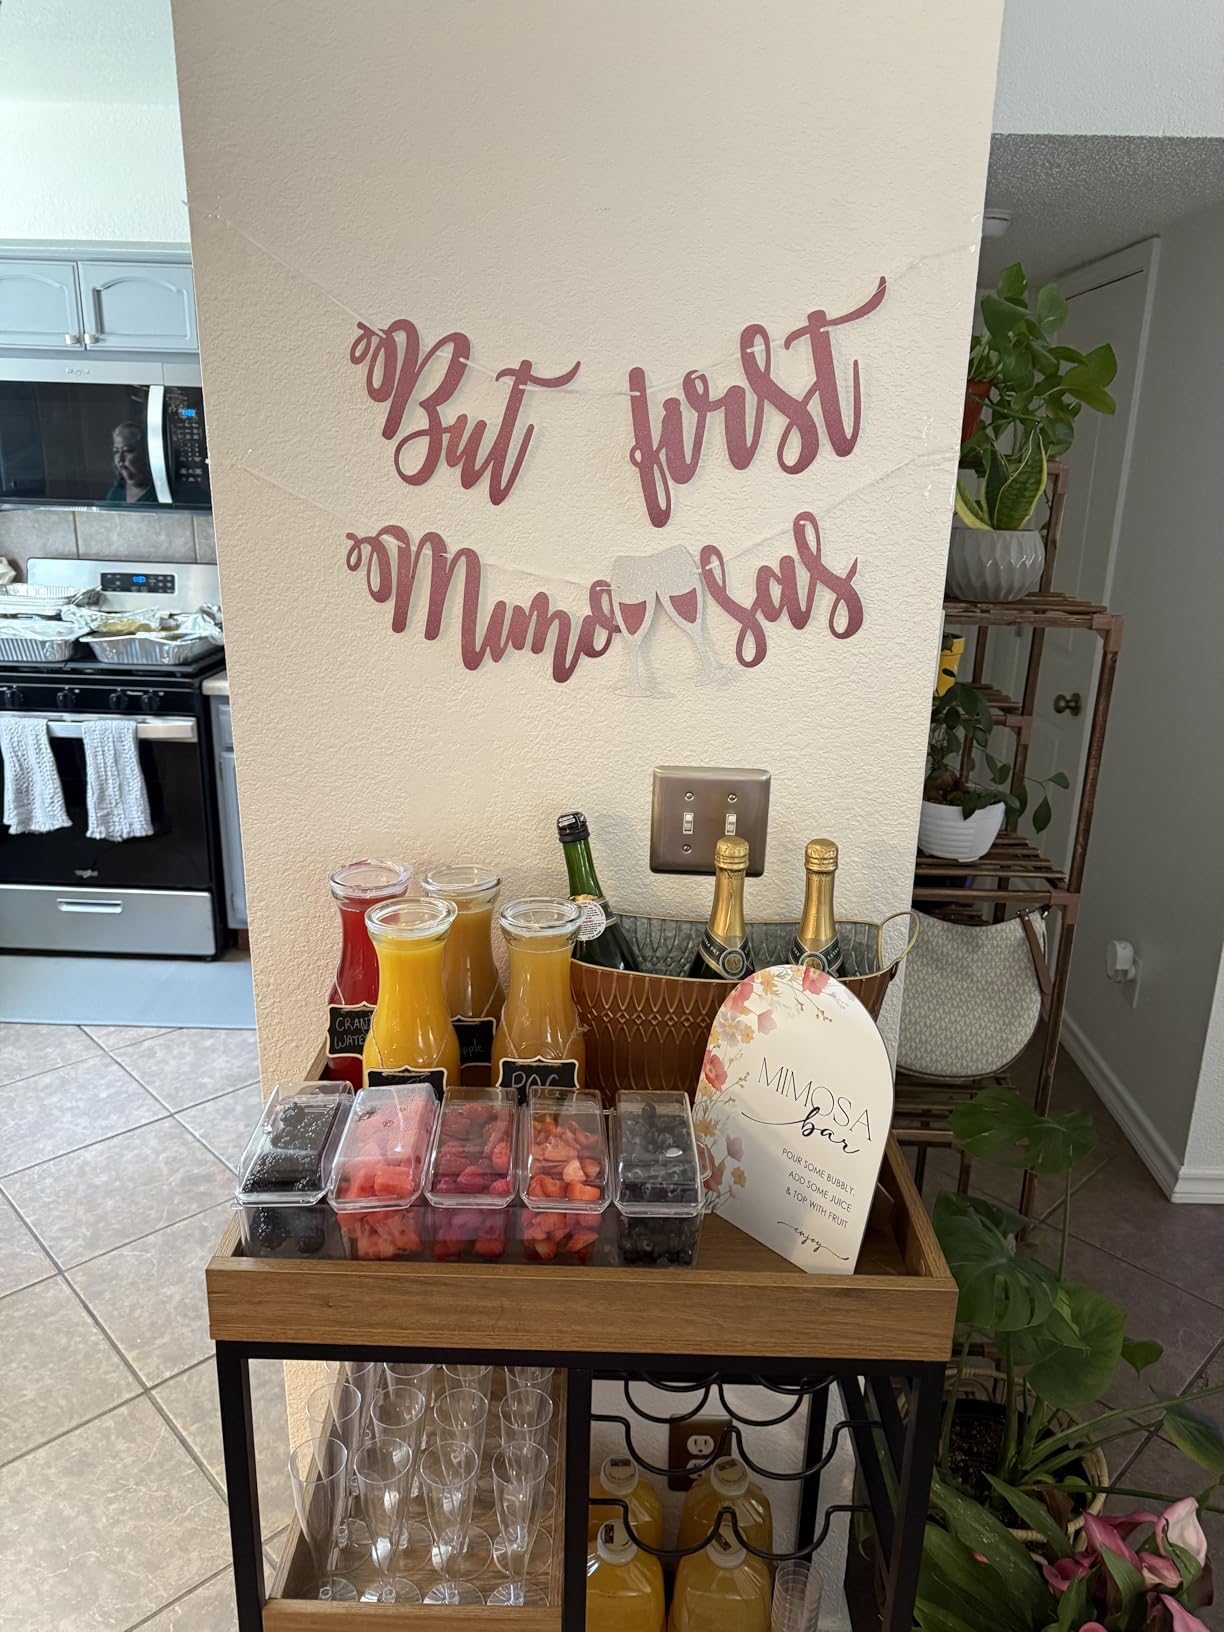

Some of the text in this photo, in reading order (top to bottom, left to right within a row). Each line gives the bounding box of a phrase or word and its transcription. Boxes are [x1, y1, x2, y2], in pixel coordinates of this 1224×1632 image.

[350, 276, 887, 529] But first
[334, 1033, 366, 1050] WATE
[758, 1057, 872, 1141] MIMOSA
[741, 1106, 860, 1154] bar
[782, 1148, 803, 1166] POUR
[804, 1160, 825, 1179] SOME
[785, 1186, 848, 1229] & TOP WITH FRUIT
[788, 1170, 852, 1213] ADD SOME JUICE
[777, 1221, 849, 1260] enjoy
